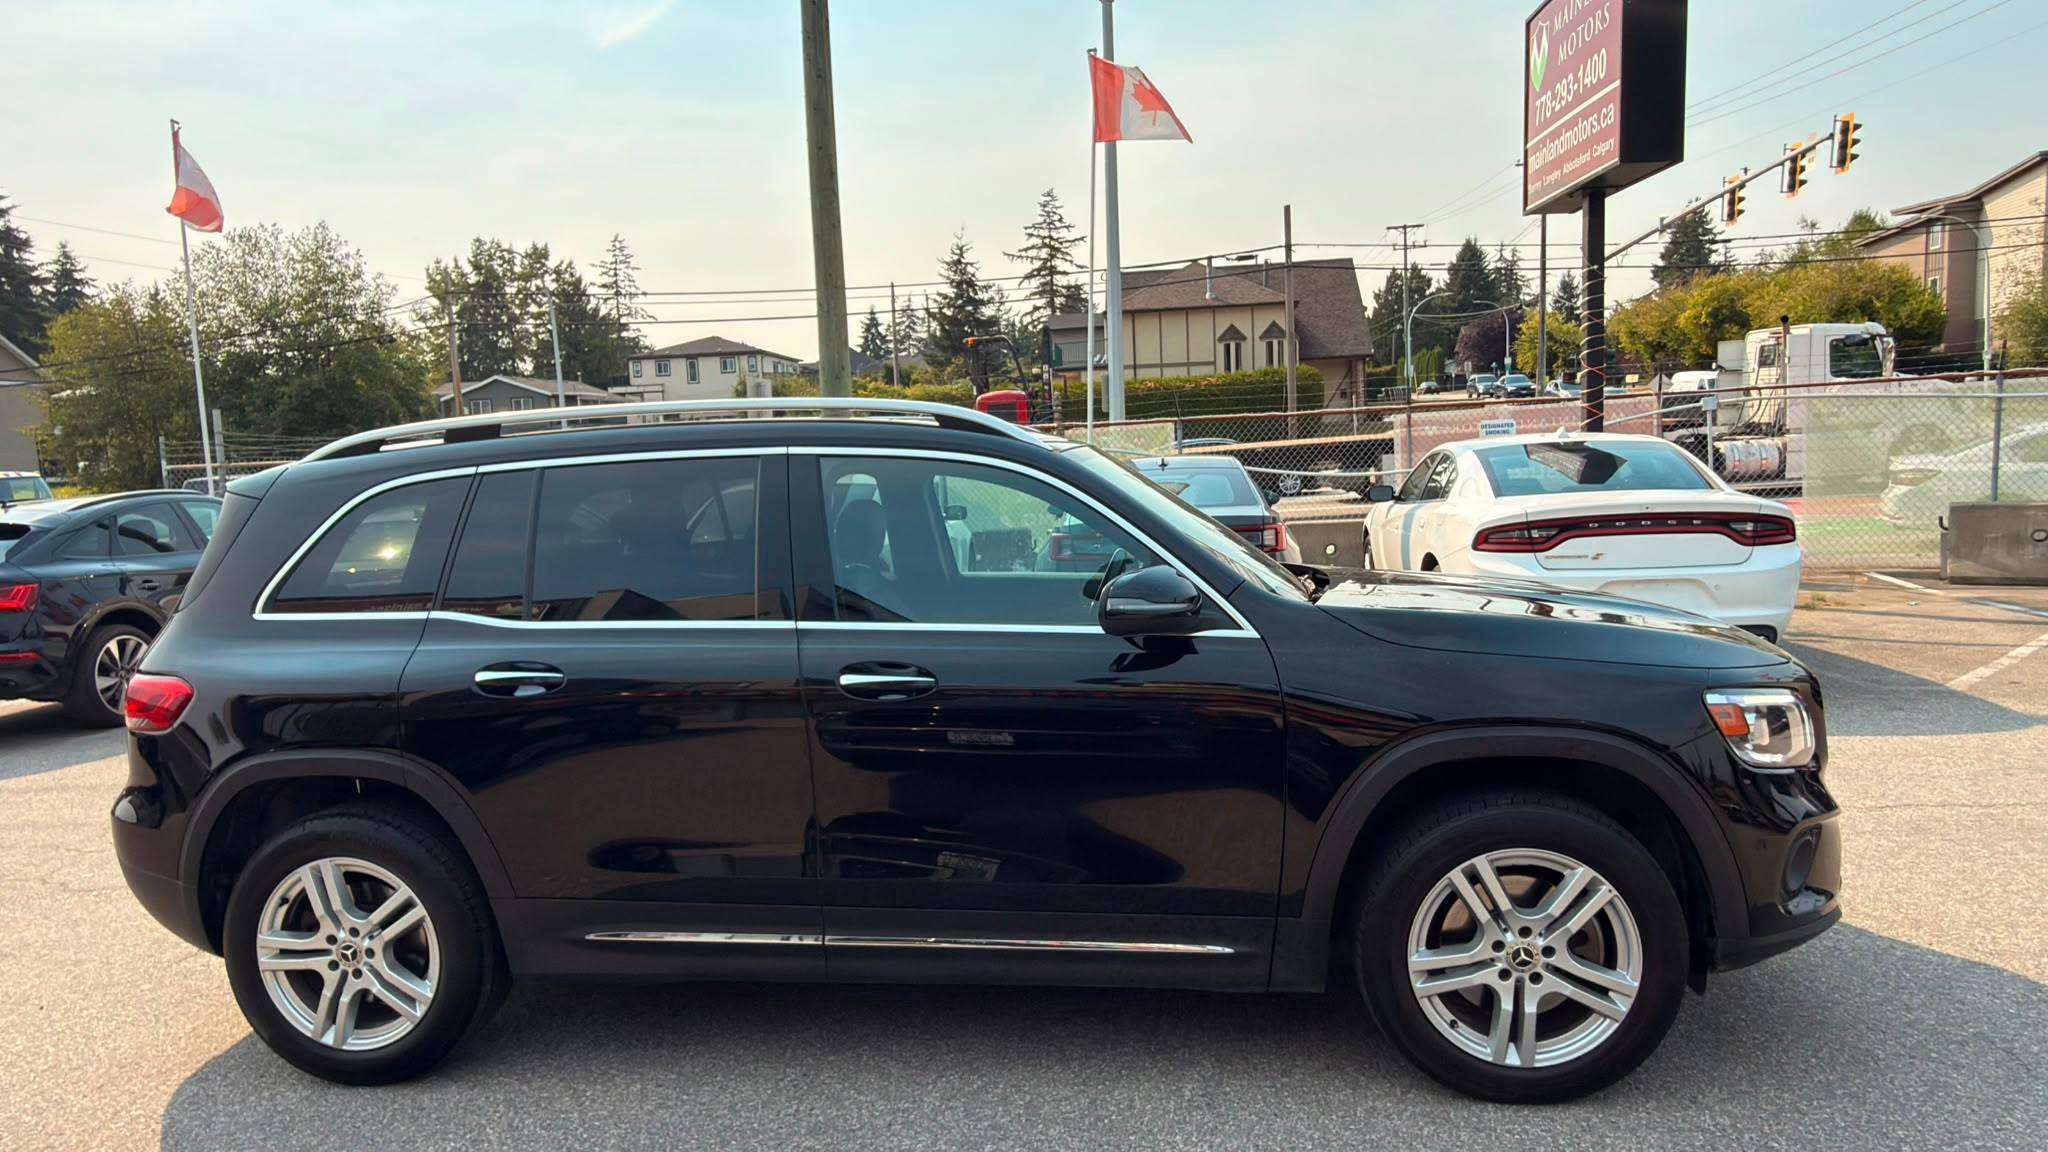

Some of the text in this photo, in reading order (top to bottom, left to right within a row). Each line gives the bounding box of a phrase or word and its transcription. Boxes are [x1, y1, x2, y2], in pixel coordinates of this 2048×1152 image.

[1559, 2, 1610, 65] MOTORS
[1535, 48, 1607, 127] 778-293-1400
[1528, 103, 1615, 175] mainlandmotors.ca
